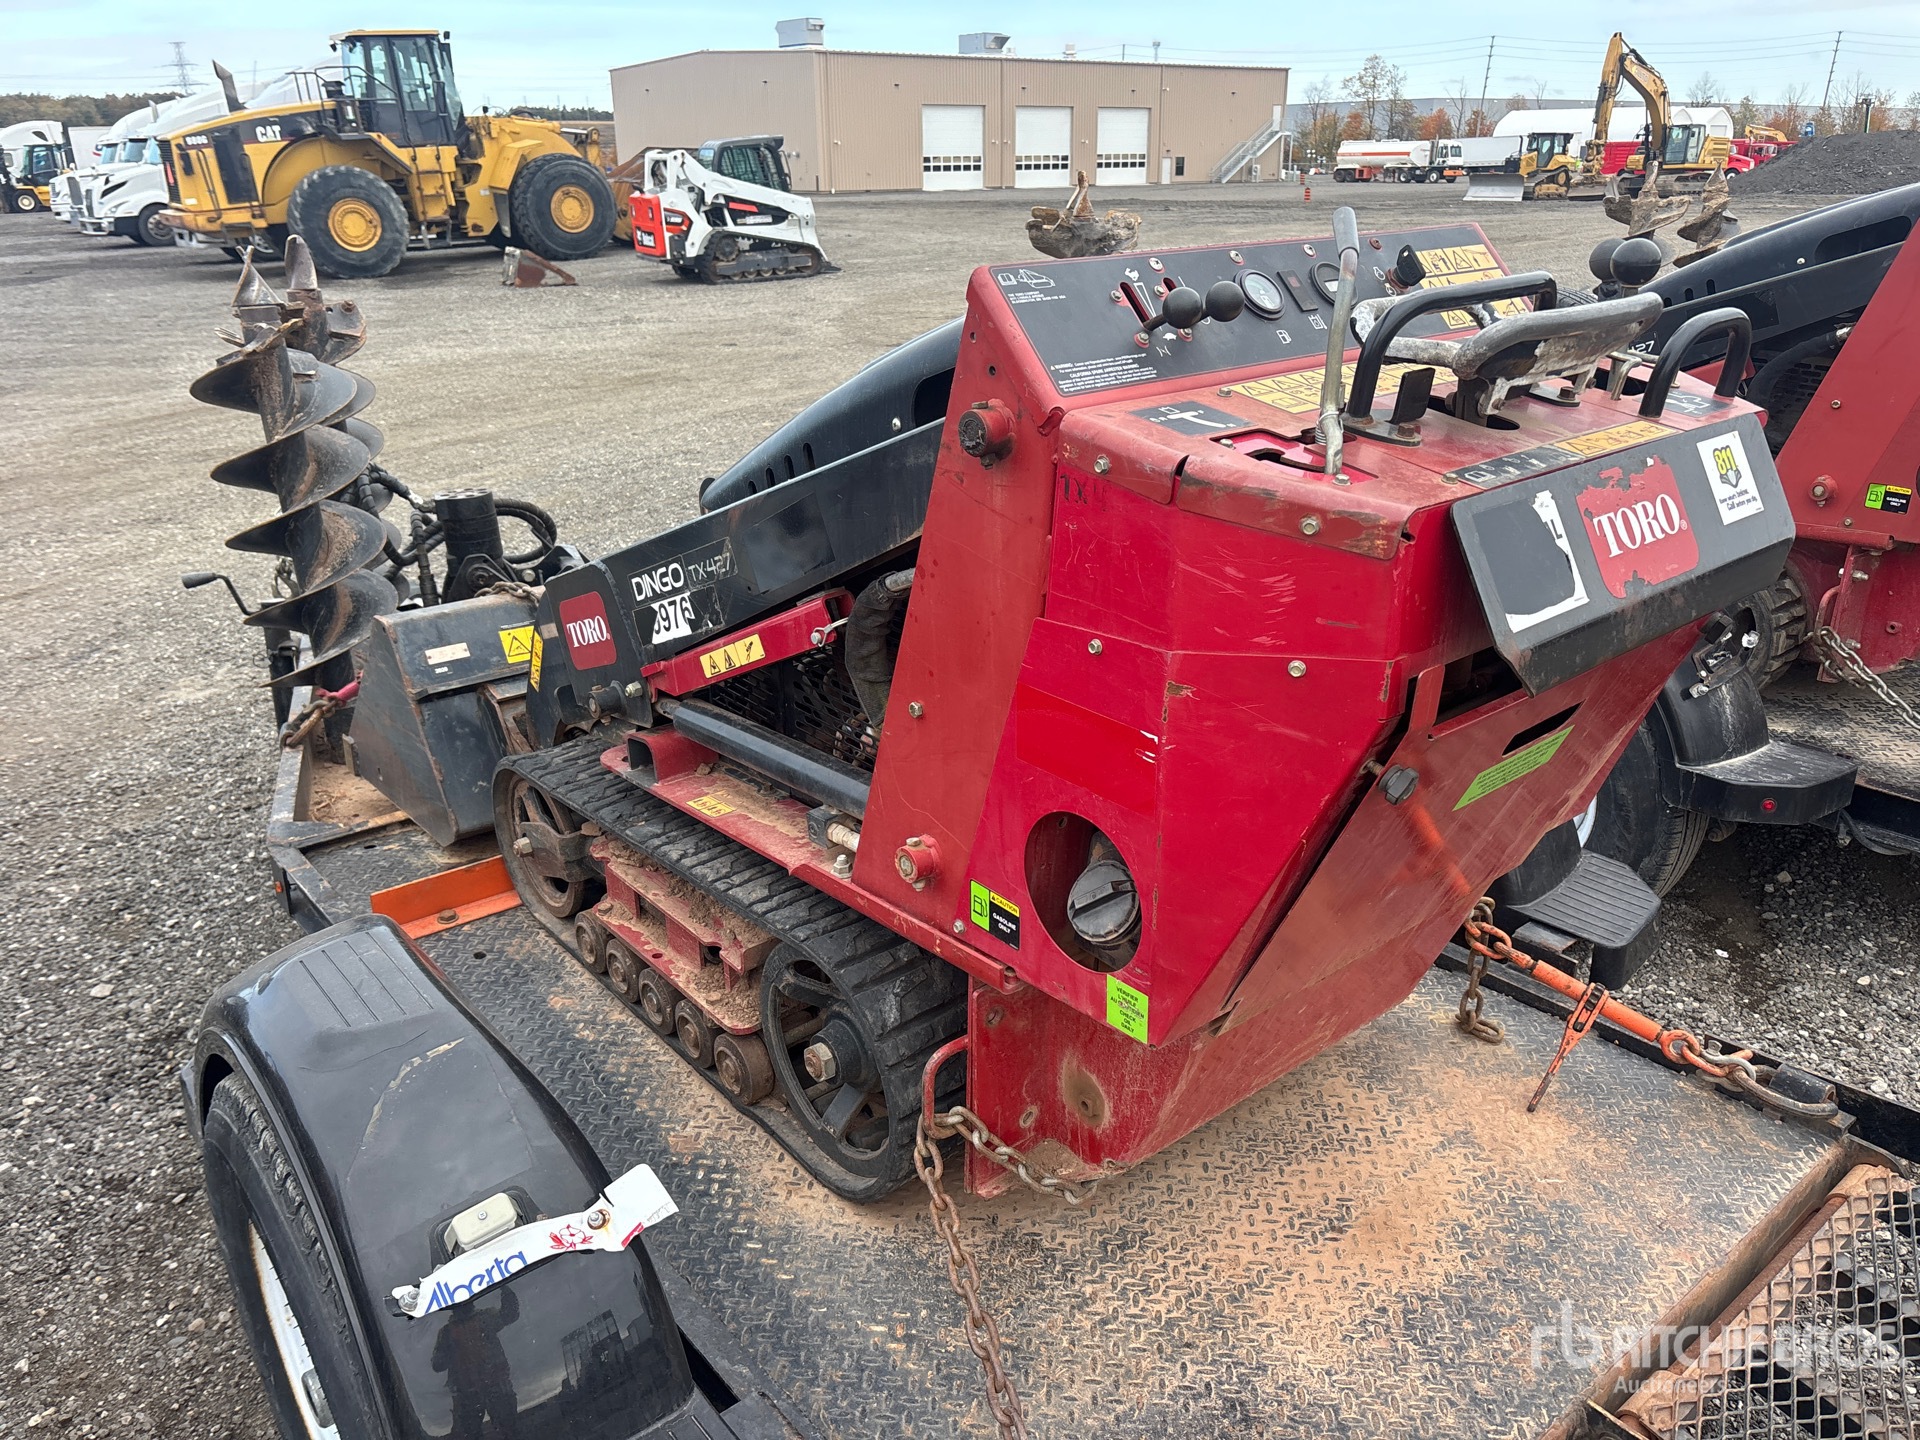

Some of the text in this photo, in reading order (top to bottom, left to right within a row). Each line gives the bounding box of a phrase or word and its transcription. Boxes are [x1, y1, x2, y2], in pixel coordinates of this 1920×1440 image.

[254, 124, 282, 143] CAT
[1713, 445, 1738, 476] 811
[1592, 493, 1681, 558] TORO
[631, 562, 685, 602] DINGO
[566, 615, 608, 648] TORO
[995, 896, 1018, 915] CAUTION
[992, 912, 1017, 931] GASOLINE
[997, 922, 1011, 934] ONLY
[424, 1250, 528, 1315] Alberta
